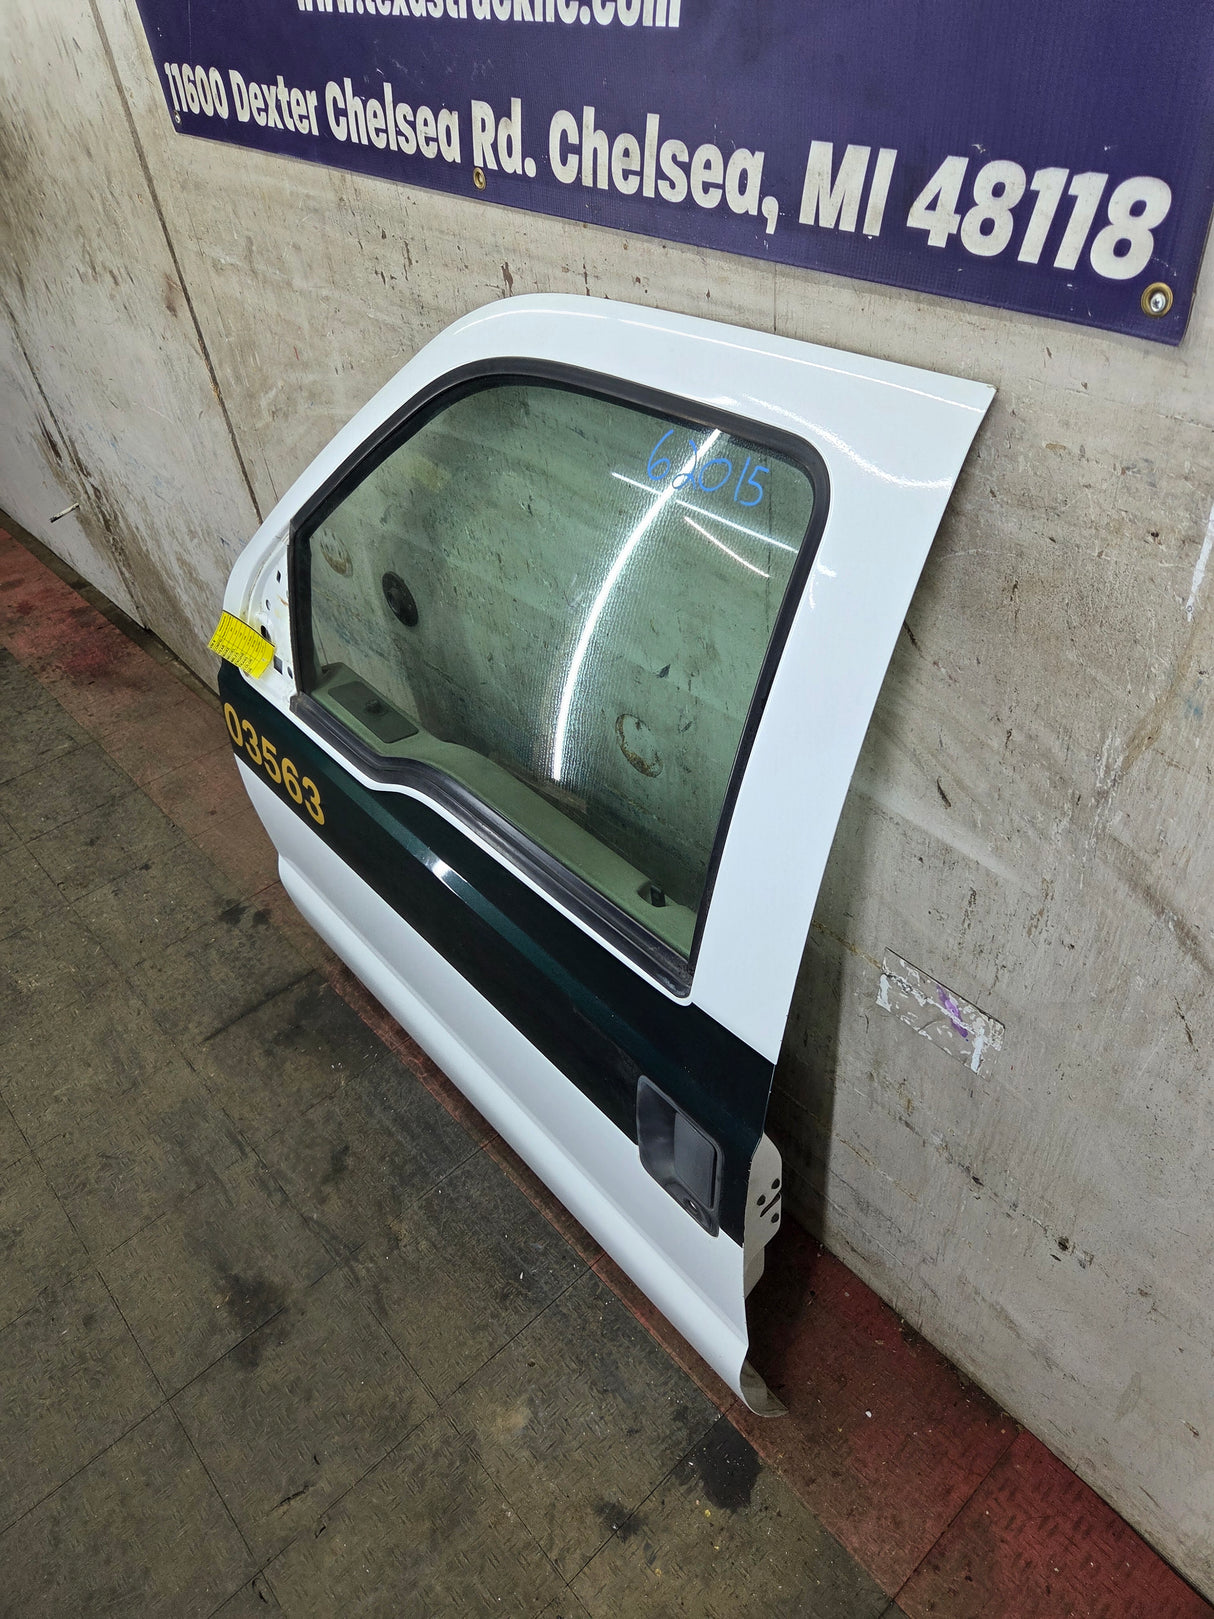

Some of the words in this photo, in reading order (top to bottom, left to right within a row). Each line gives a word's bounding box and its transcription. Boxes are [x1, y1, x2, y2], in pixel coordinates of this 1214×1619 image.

[164, 62, 228, 120] 11600
[229, 69, 319, 136] Dexter
[325, 77, 461, 164] Chelsea
[471, 97, 537, 178] Rd.
[549, 105, 779, 234] Chelsea,
[799, 140, 898, 237] MI
[906, 155, 1172, 281] 48118
[647, 429, 770, 507] 62015
[224, 702, 325, 825] 03563
